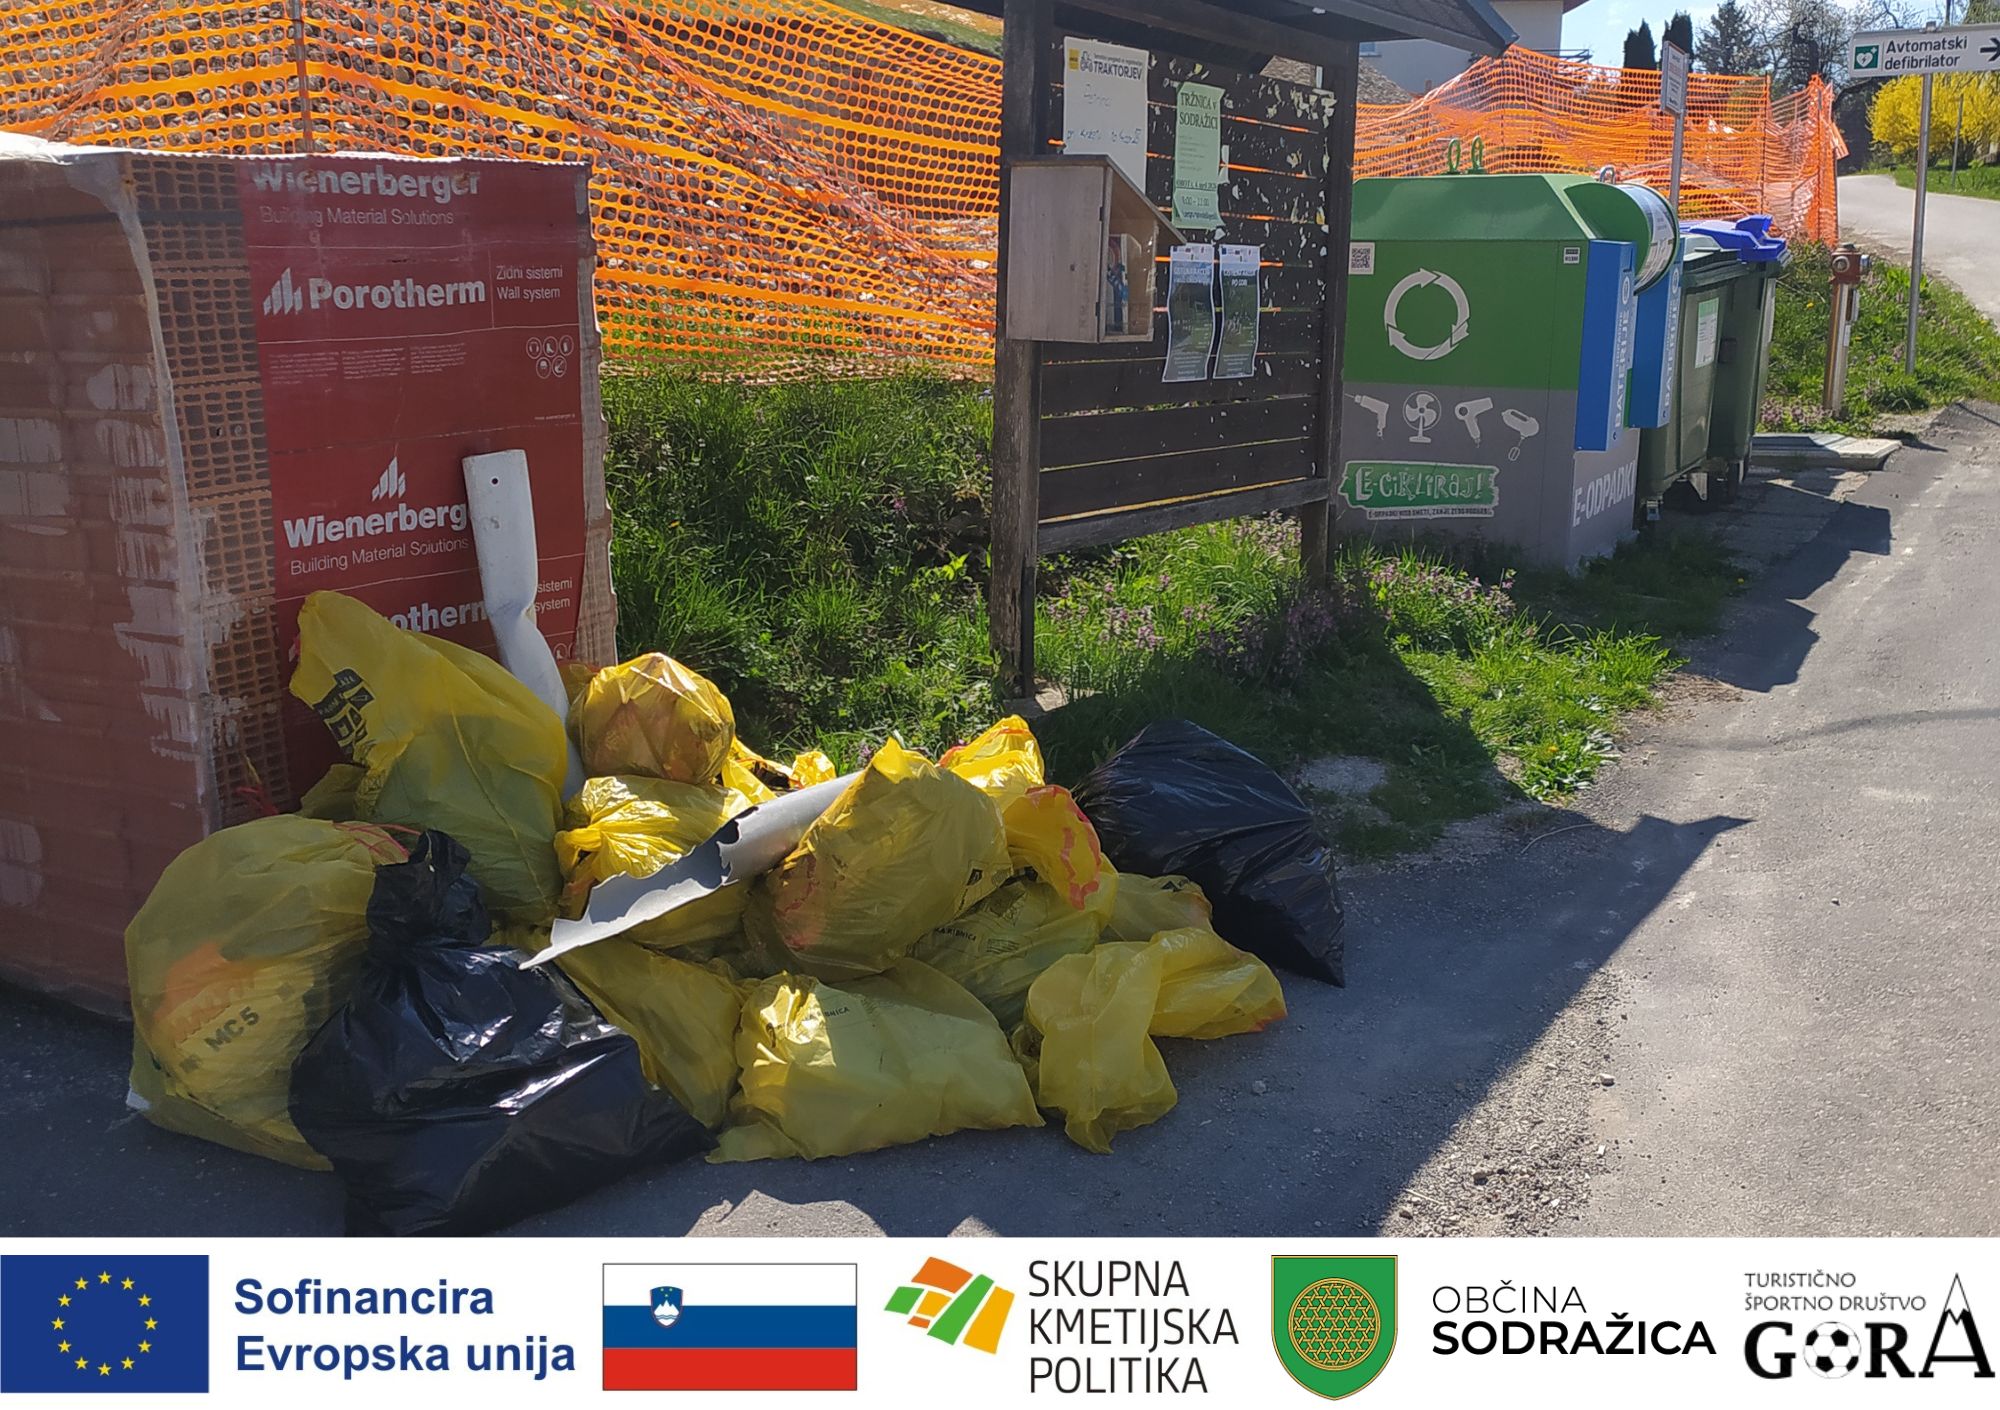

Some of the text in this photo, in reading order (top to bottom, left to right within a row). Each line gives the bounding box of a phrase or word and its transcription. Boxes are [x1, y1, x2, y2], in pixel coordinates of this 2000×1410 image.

[1886, 36, 1967, 54] Avtomatski
[1094, 61, 1142, 80] TRAKTORJEV
[1884, 55, 1961, 70] defibrilator
[1180, 92, 1212, 110] TRŽNICA
[1179, 112, 1218, 130] SODRAŽICI
[248, 162, 480, 204] Wienerberger
[327, 208, 386, 225] Material
[391, 208, 455, 225] Solutions
[496, 265, 563, 280] Zidni sistemi
[309, 278, 486, 310] Porotherm
[497, 286, 561, 302] Wall system
[1615, 309, 1630, 429] BATERIJE
[1573, 460, 1636, 527] E-ODPADKI
[284, 501, 468, 549] Wienerberg
[290, 536, 470, 576] Building Material Solutions
[537, 577, 573, 593] sistemi
[535, 598, 570, 615] system
[385, 602, 488, 633] otherm
[204, 1006, 260, 1051] MC 5
